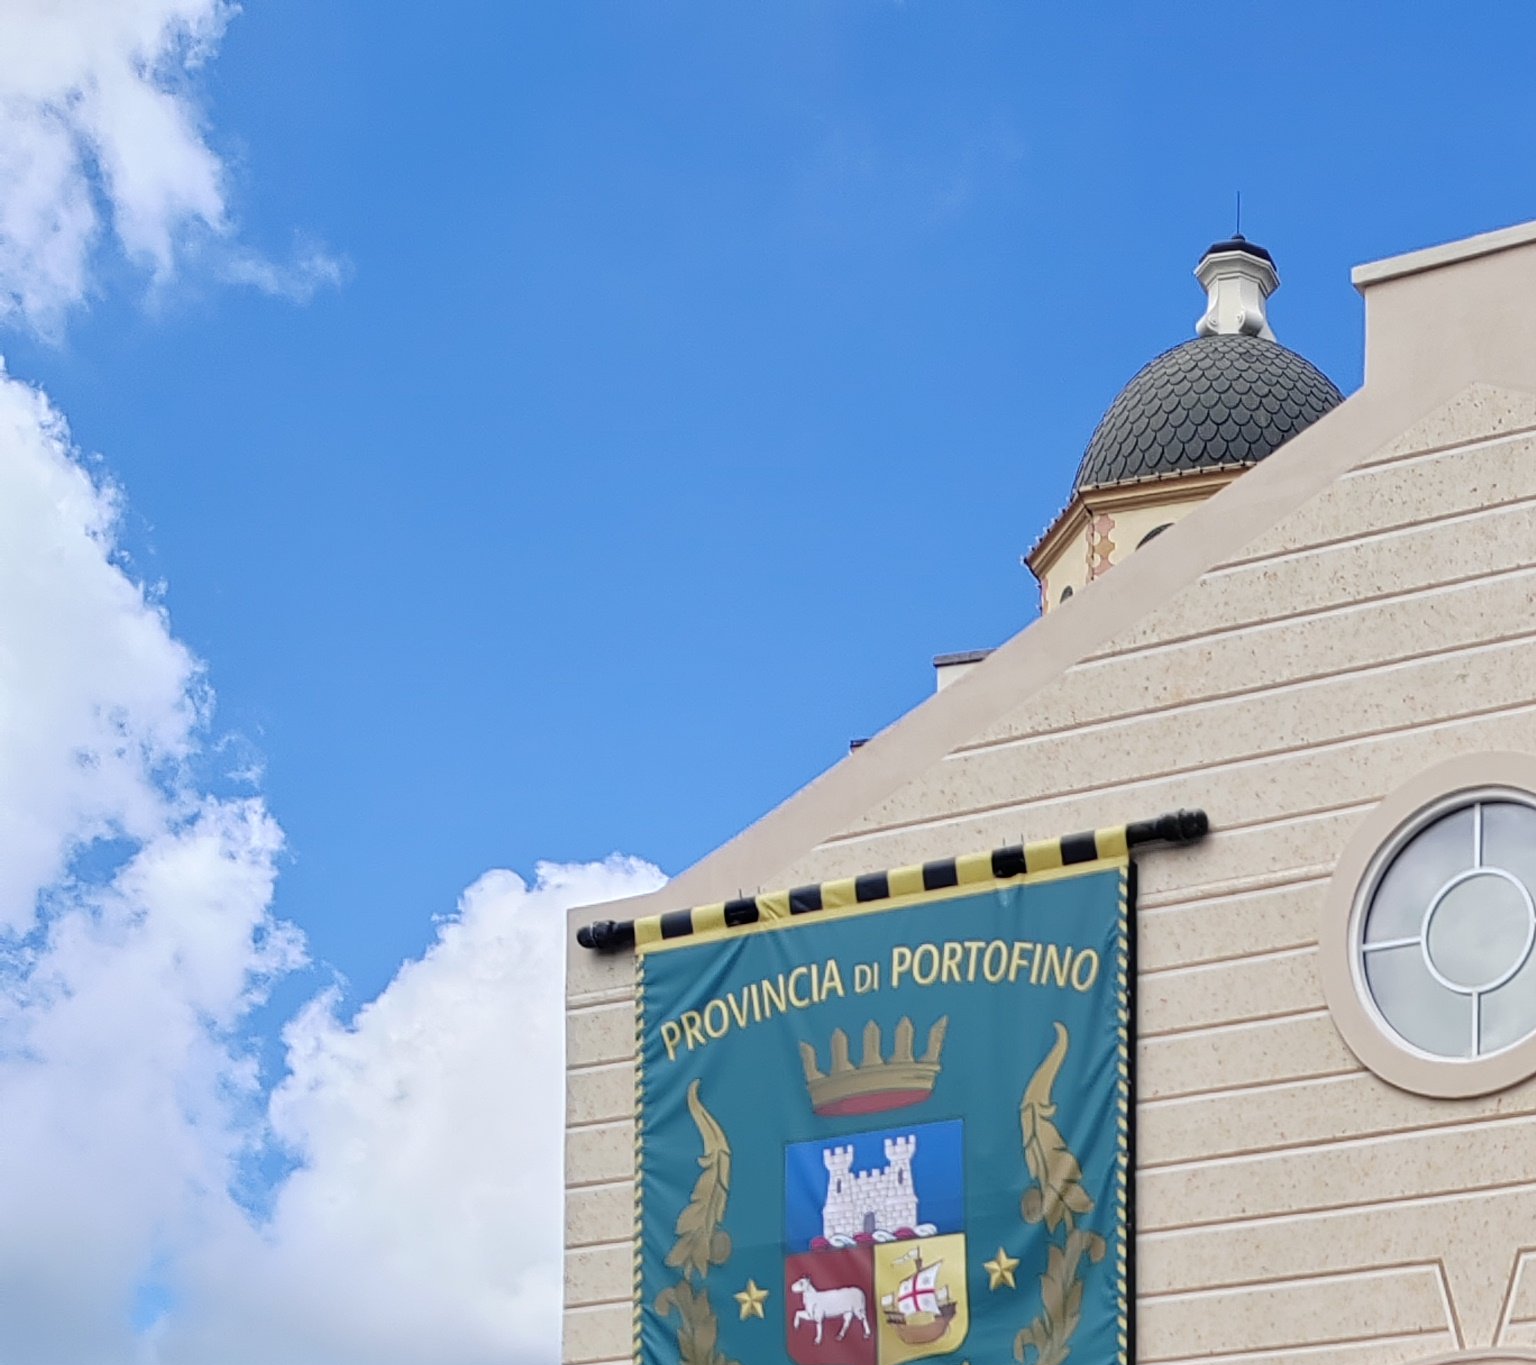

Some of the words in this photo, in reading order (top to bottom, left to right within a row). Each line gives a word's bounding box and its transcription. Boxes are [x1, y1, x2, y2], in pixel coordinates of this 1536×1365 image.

[660, 959, 844, 1061] PROVINCIA
[854, 963, 879, 994] DI
[891, 940, 1098, 992] PORTOFINO
